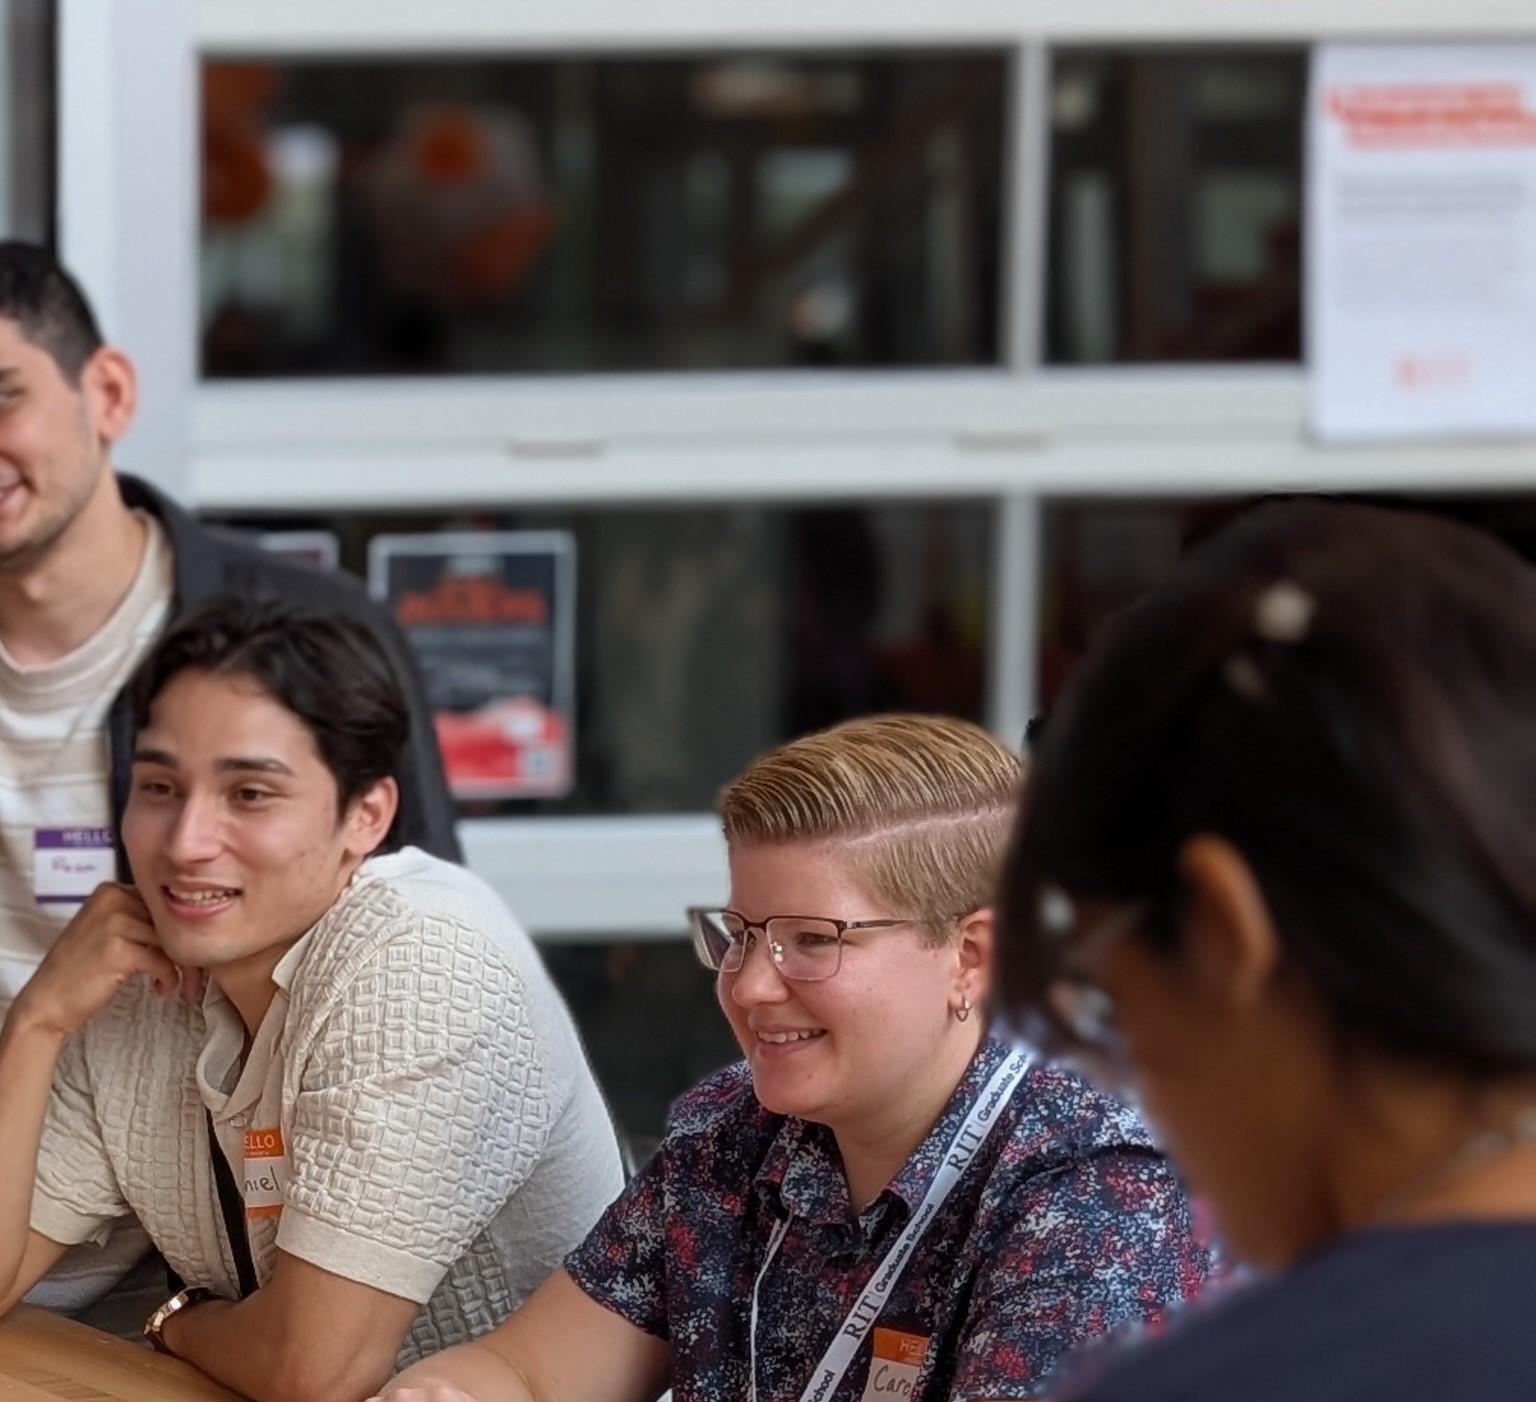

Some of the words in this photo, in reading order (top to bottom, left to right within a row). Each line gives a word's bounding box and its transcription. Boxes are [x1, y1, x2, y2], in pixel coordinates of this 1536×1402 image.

[245, 1134, 275, 1149] ELLO
[945, 1124, 983, 1171] RIT
[977, 1073, 1015, 1122] Graduate
[245, 1165, 280, 1192] niel
[842, 1295, 880, 1341] RIT
[874, 1243, 911, 1292] Graduate
